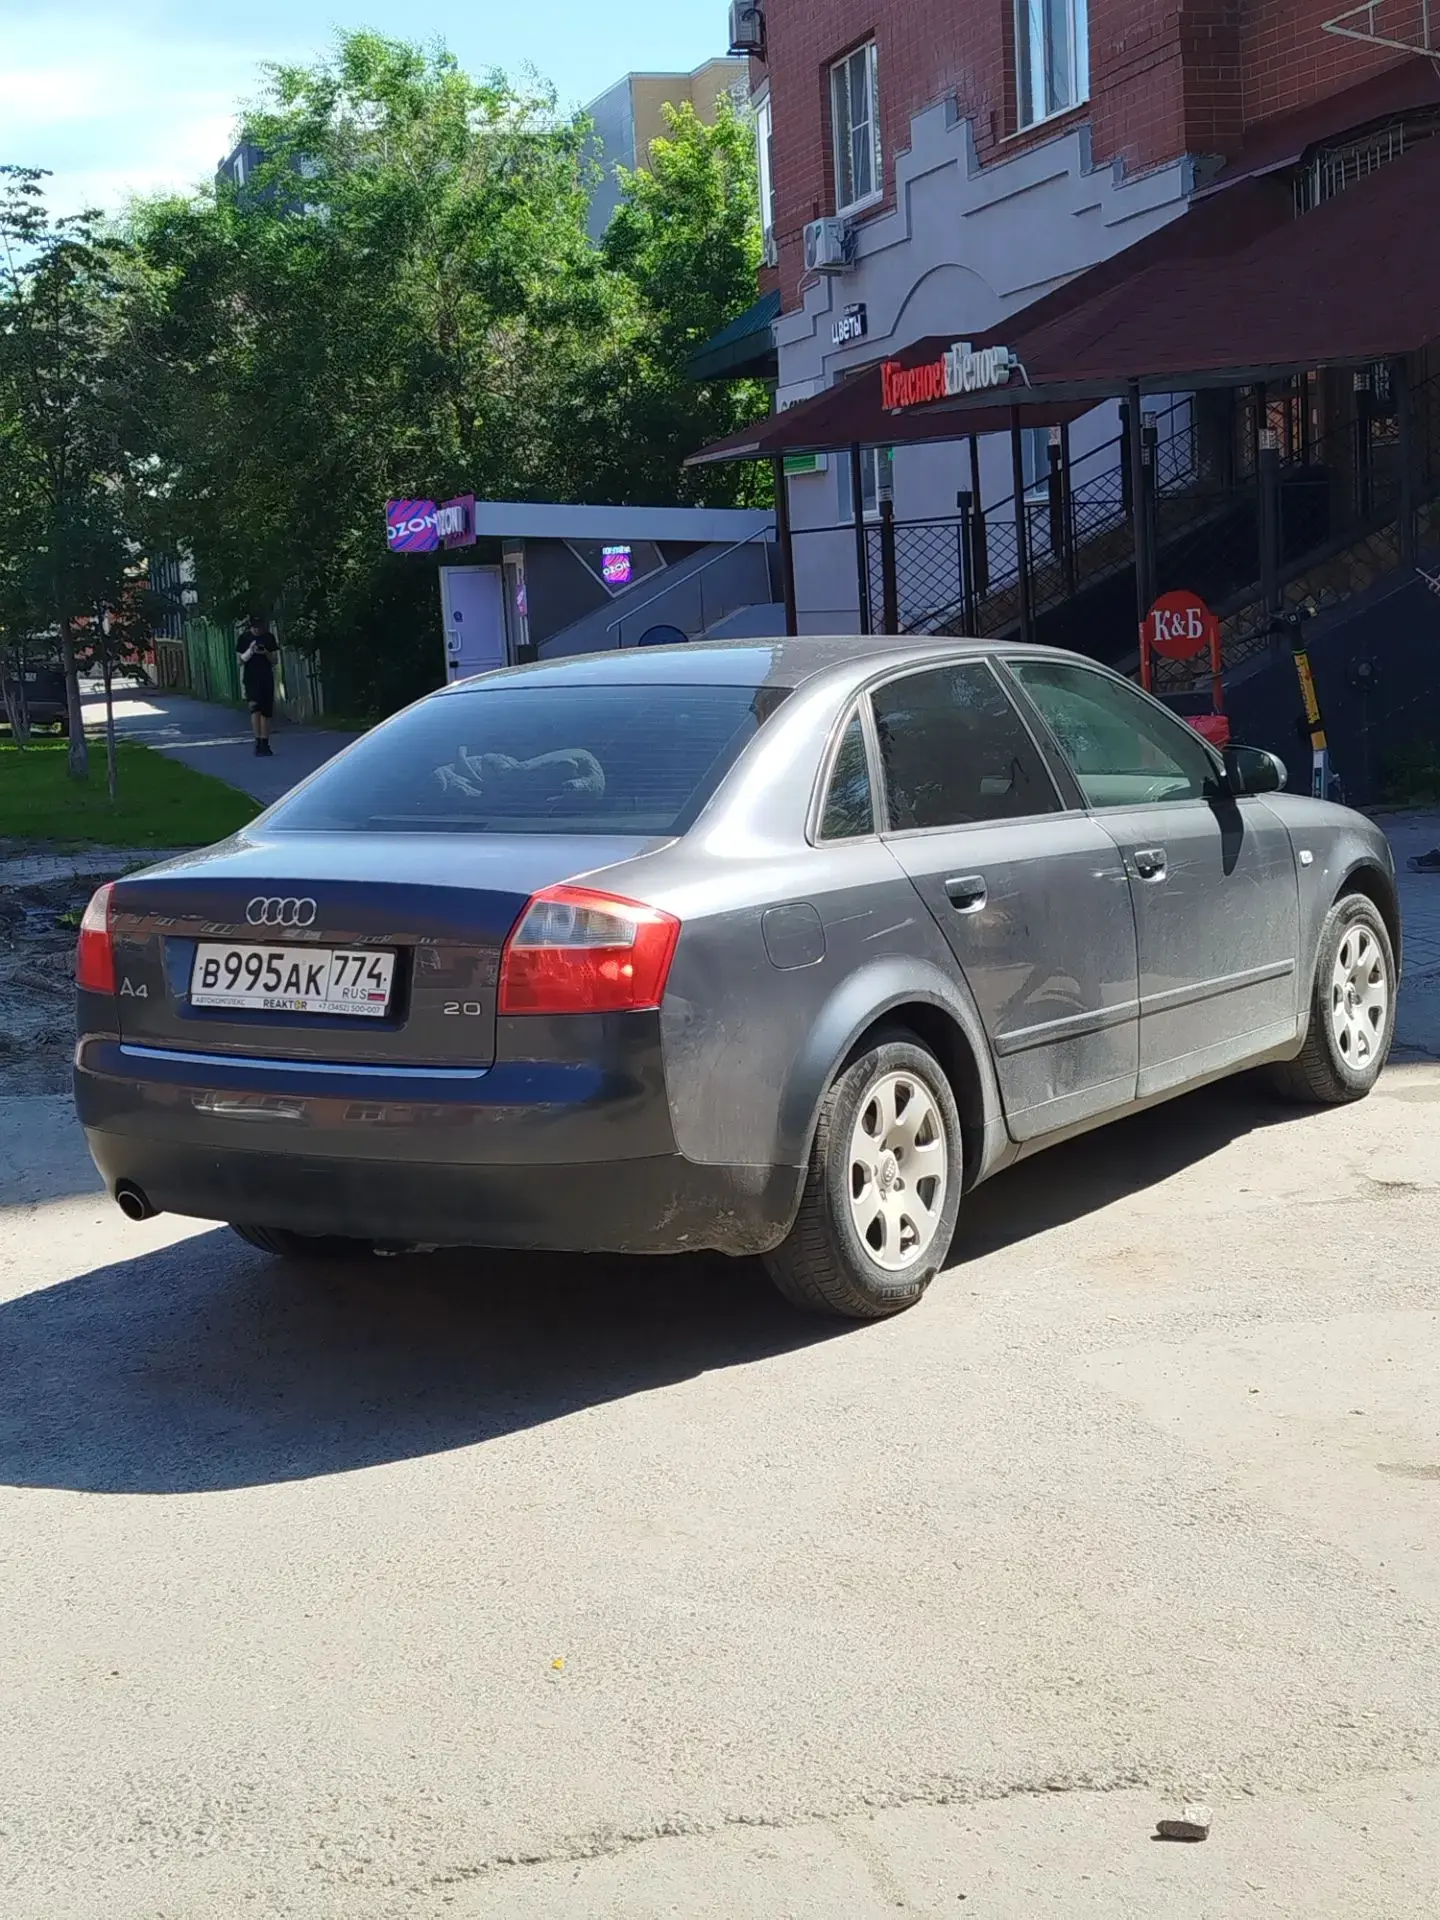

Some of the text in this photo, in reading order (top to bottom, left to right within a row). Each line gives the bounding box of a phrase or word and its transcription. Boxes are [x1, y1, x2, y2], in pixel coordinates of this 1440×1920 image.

[387, 513, 438, 540] OZON
[602, 560, 631, 576] OZON
[1151, 608, 1203, 641] К&Б
[201, 951, 384, 996] В995АК 774
[120, 976, 148, 998] A4
[341, 989, 367, 1000] RUS
[263, 999, 308, 1010] REAKTOR
